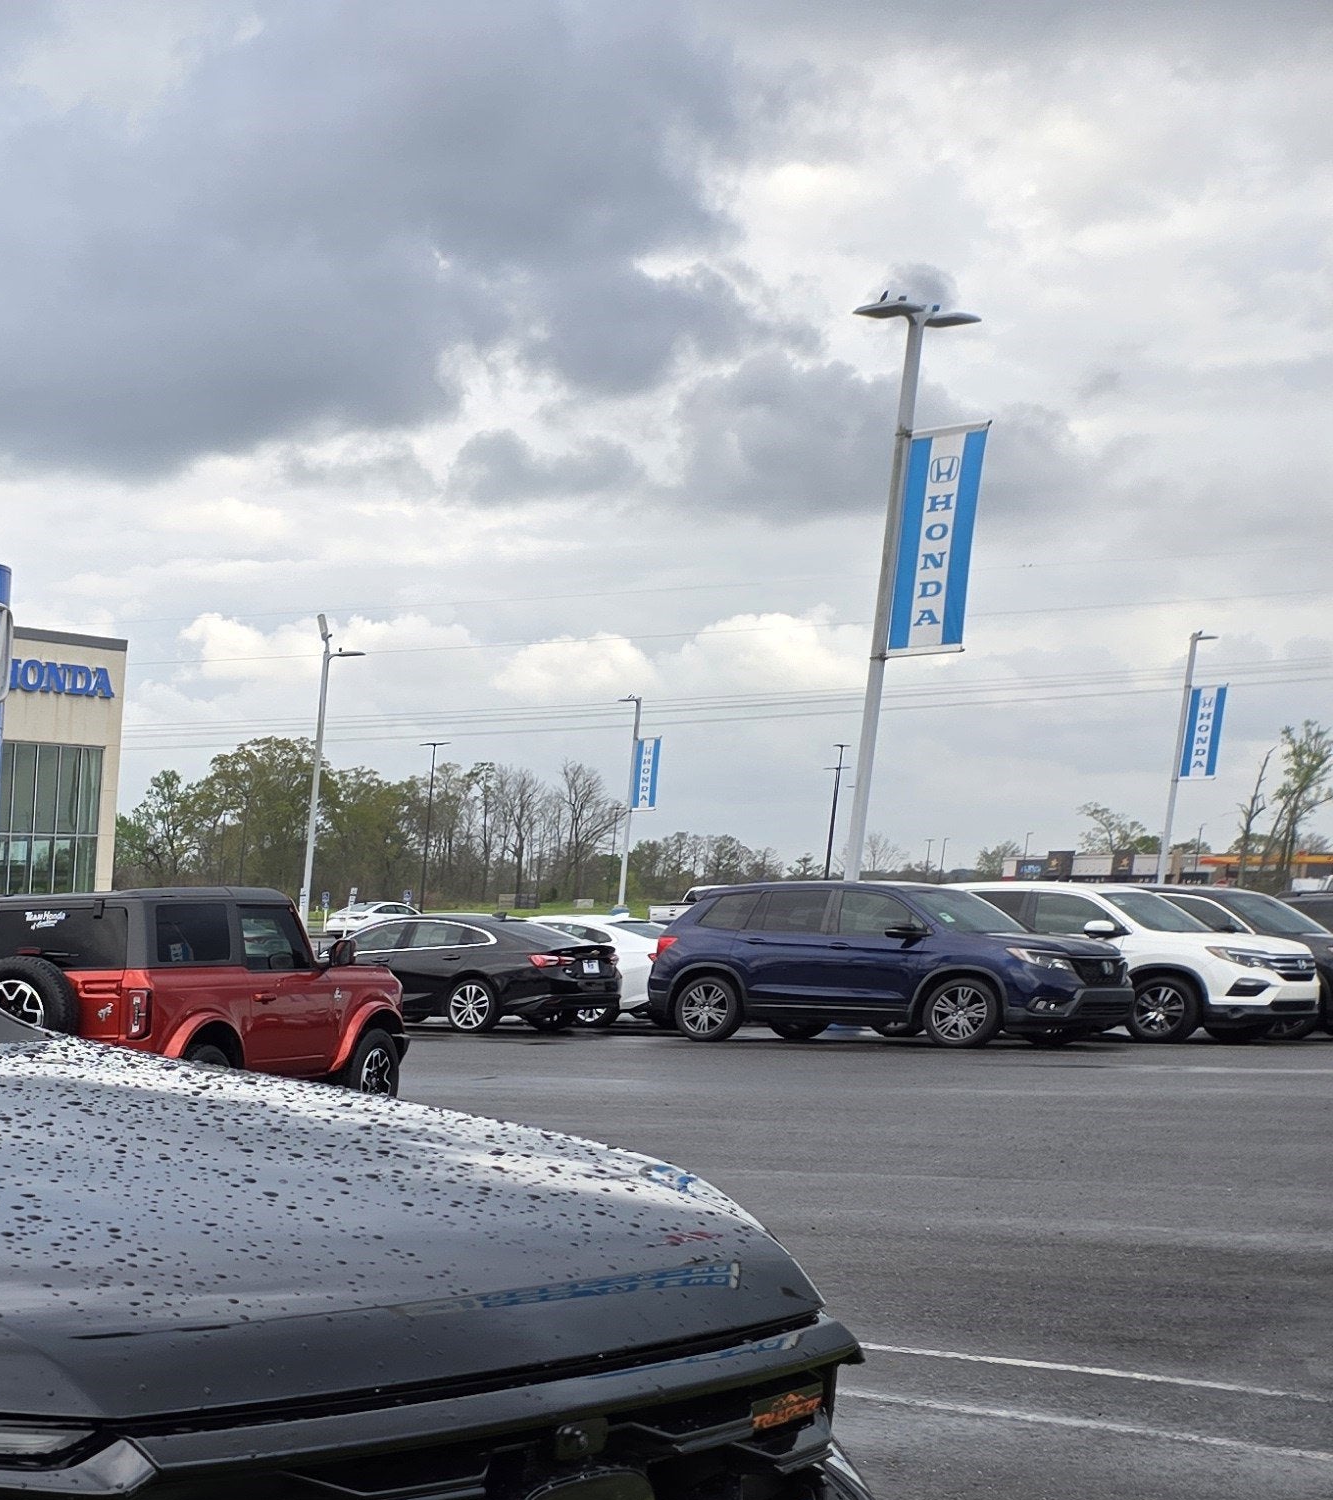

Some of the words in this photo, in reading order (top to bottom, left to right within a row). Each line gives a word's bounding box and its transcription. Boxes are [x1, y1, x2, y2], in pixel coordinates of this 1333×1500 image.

[913, 493, 954, 626] HONDA
[1192, 712, 1212, 768] HONDA
[640, 758, 651, 801] HONDA
